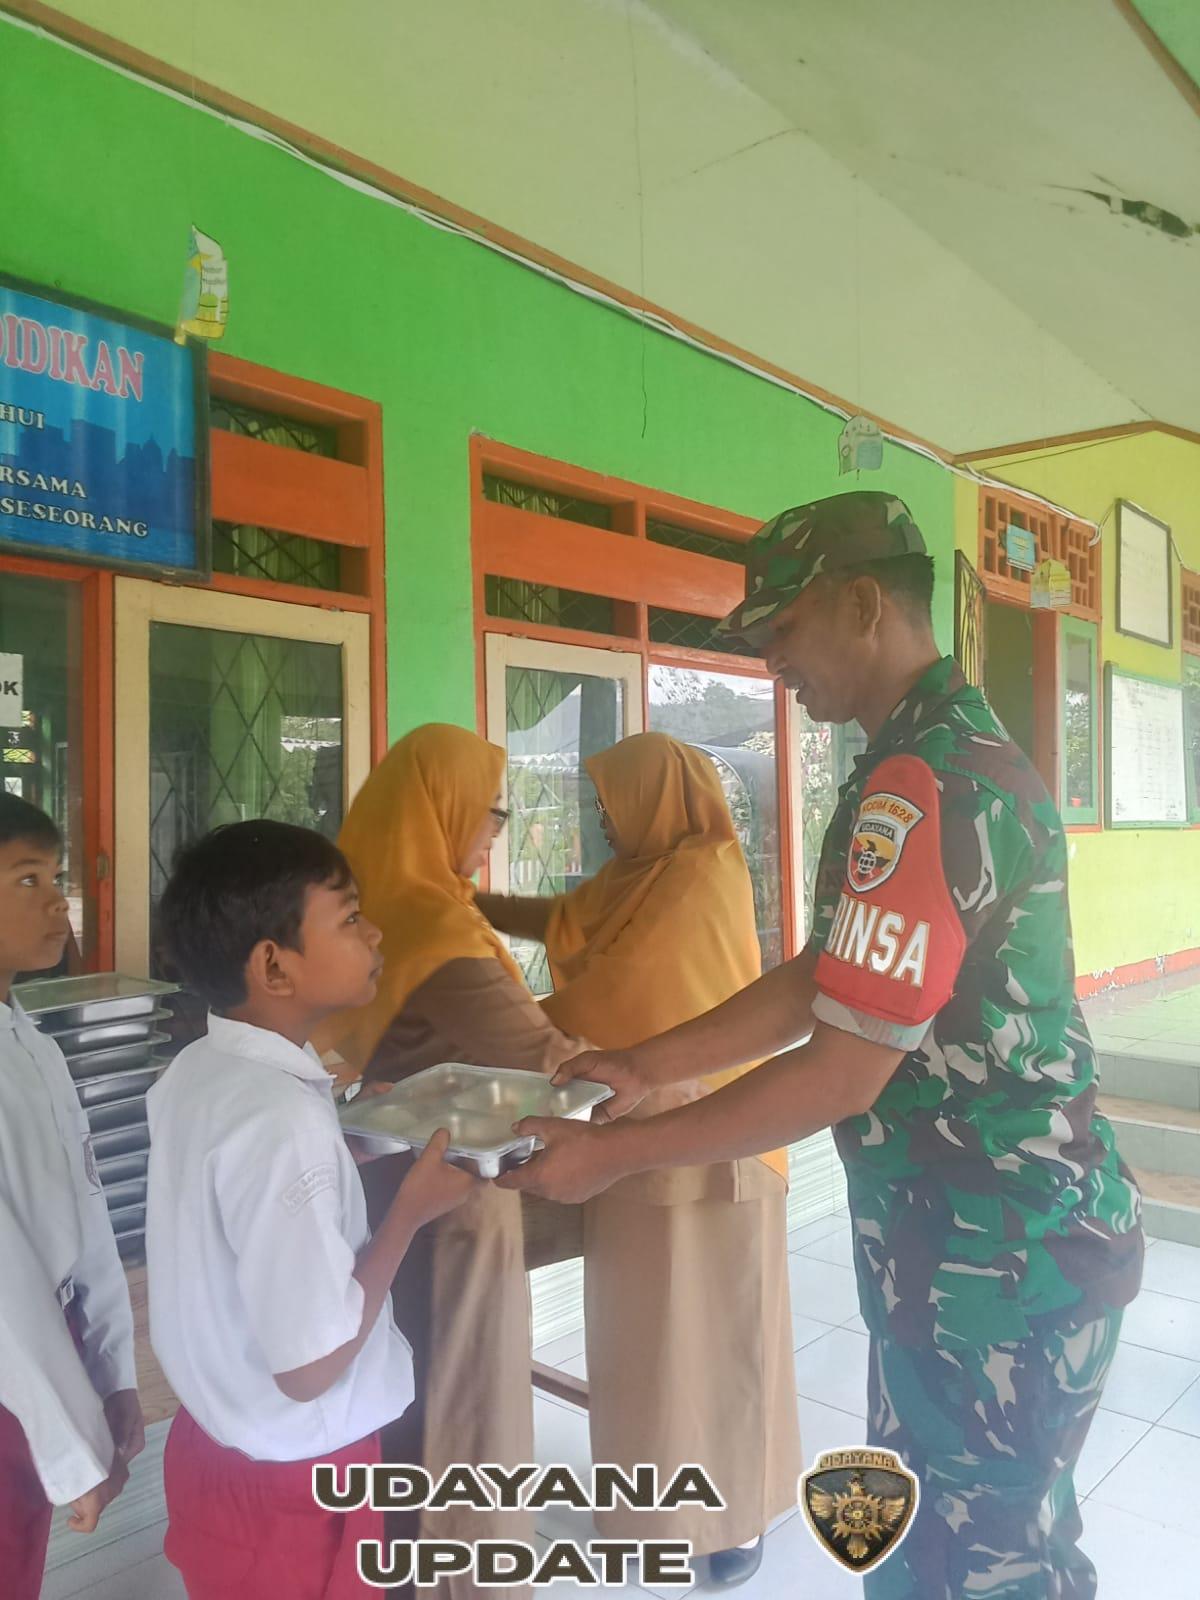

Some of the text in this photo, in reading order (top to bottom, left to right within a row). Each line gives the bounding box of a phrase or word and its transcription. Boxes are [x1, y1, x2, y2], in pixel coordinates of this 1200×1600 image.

[0, 313, 144, 402] IDIKAN
[0, 465, 87, 498] RSAMA
[0, 497, 148, 537] SESEORANG
[0, 680, 19, 696] K
[888, 803, 913, 823] 1628
